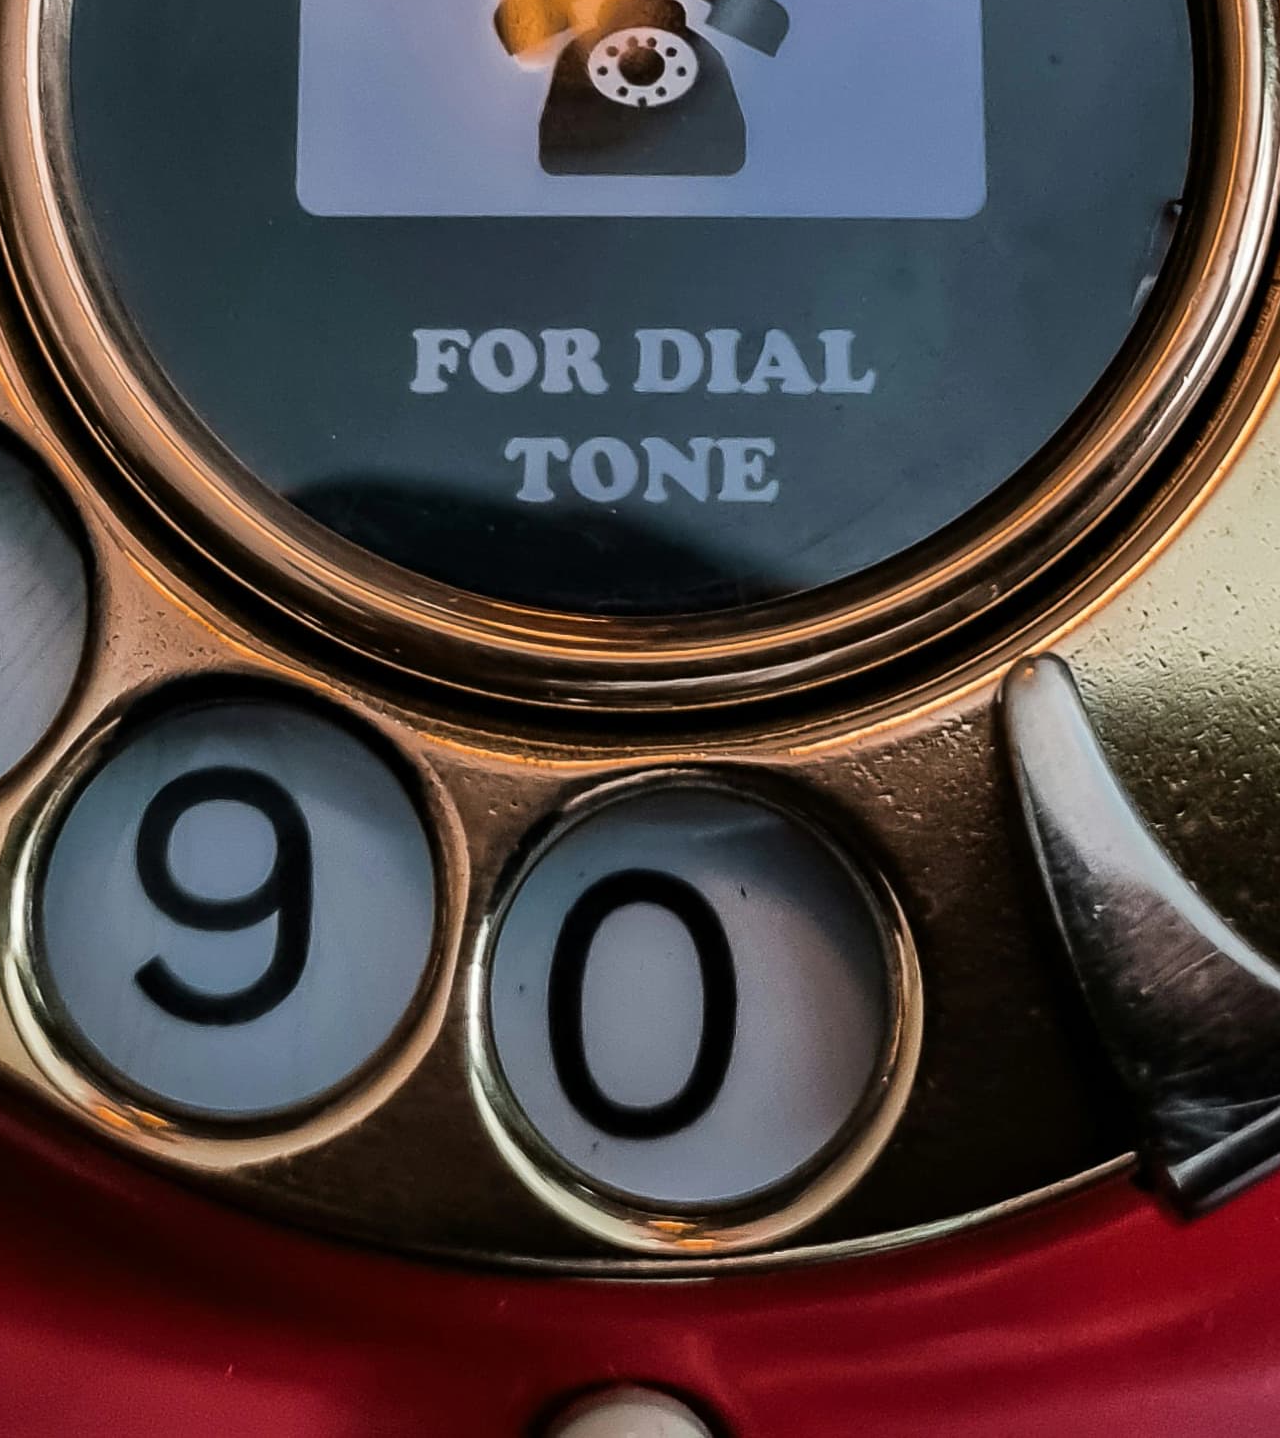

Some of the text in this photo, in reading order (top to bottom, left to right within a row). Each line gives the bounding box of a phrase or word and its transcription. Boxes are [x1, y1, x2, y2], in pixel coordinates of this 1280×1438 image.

[410, 328, 877, 394] FOR DIAL
[504, 437, 780, 503] TONE
[133, 765, 313, 1026] 9
[547, 867, 736, 1139] 0
